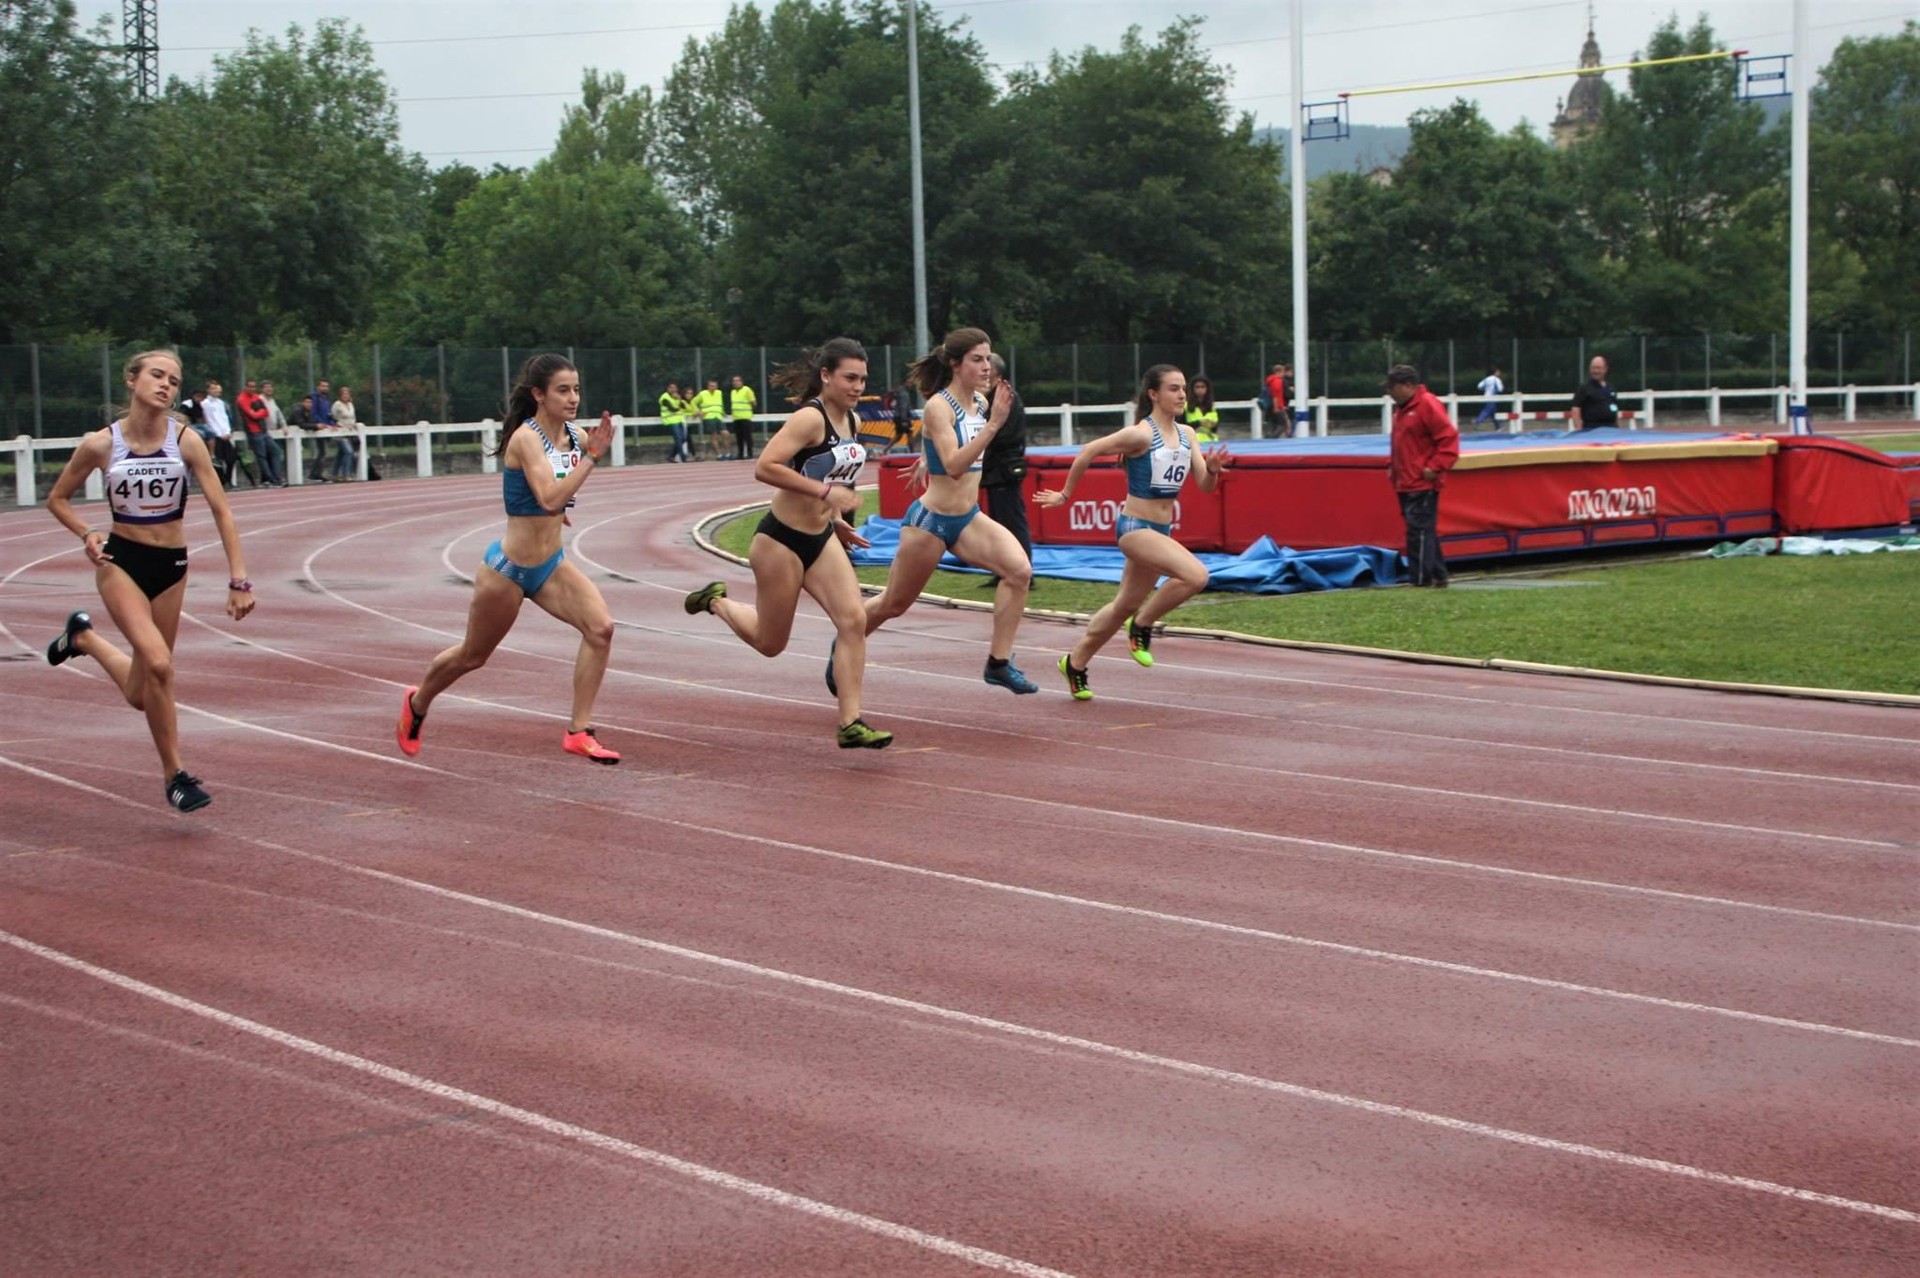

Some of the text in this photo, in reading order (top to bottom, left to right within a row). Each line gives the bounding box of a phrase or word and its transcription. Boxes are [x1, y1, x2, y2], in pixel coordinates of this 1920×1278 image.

[127, 467, 168, 476] CADETE
[828, 462, 863, 480] 447
[1163, 465, 1186, 483] 46
[115, 477, 180, 499] 4167
[1568, 485, 1657, 520] MONDO
